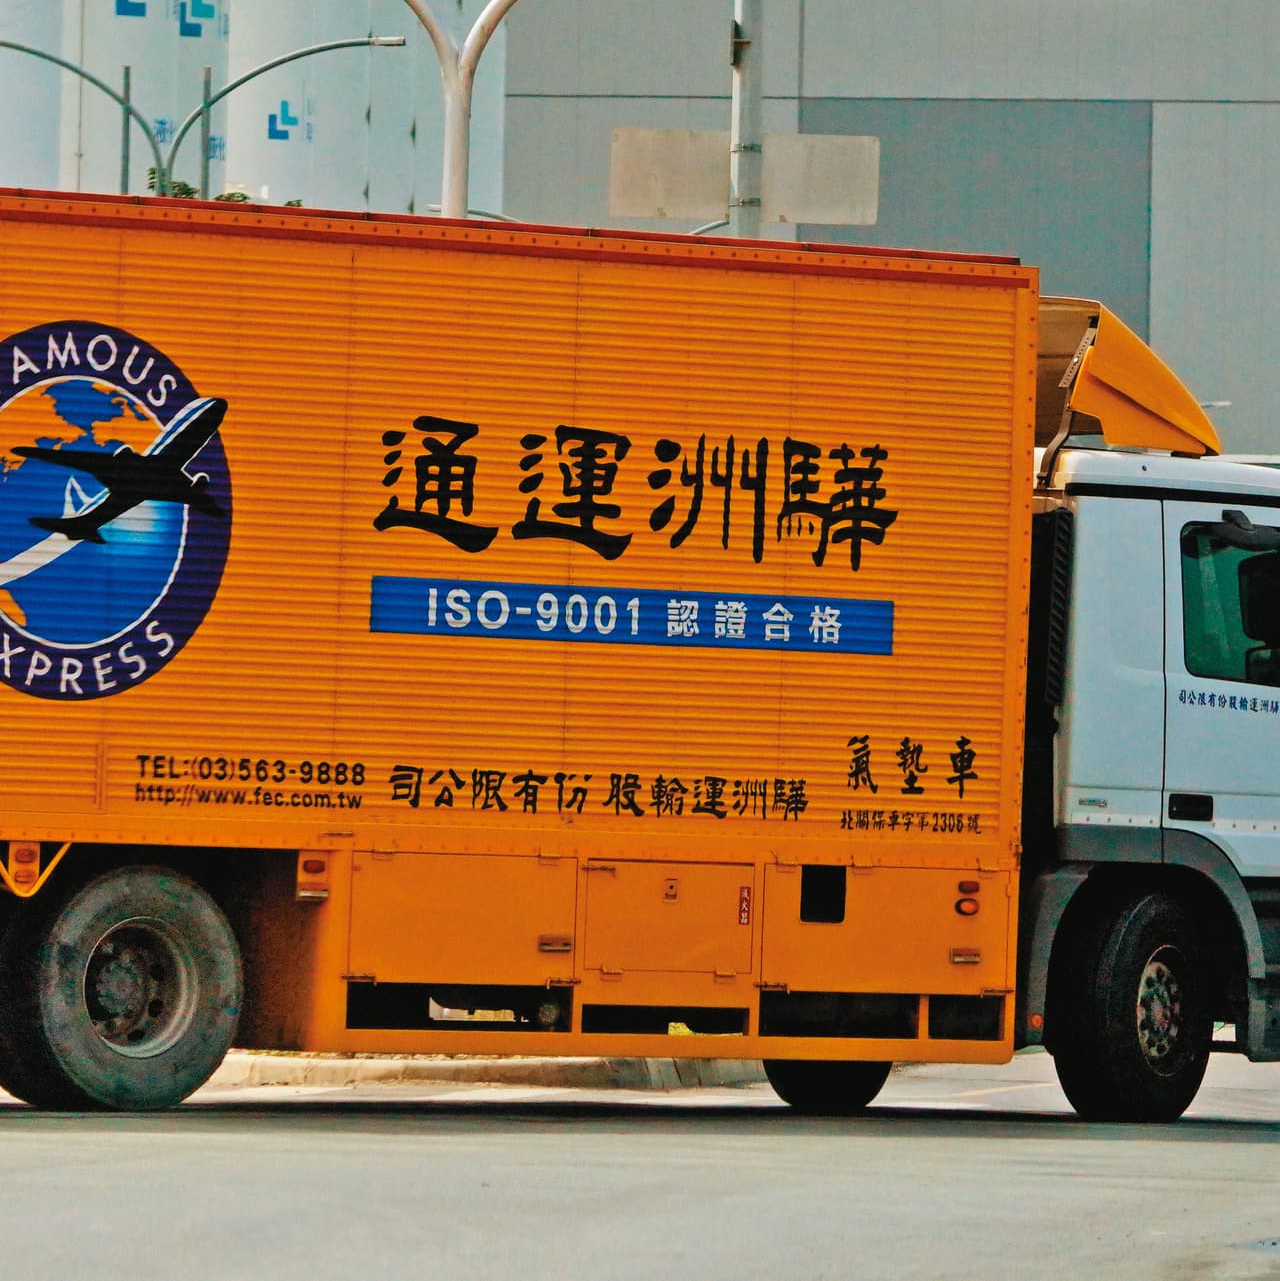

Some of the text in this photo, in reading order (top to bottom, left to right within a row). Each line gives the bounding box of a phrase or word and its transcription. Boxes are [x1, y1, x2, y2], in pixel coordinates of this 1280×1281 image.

[427, 587, 843, 645] ISO-9001 認證合格
[136, 754, 366, 786] TEL:(03)563-9888
[135, 783, 363, 810] http://www.fec.com.tw
